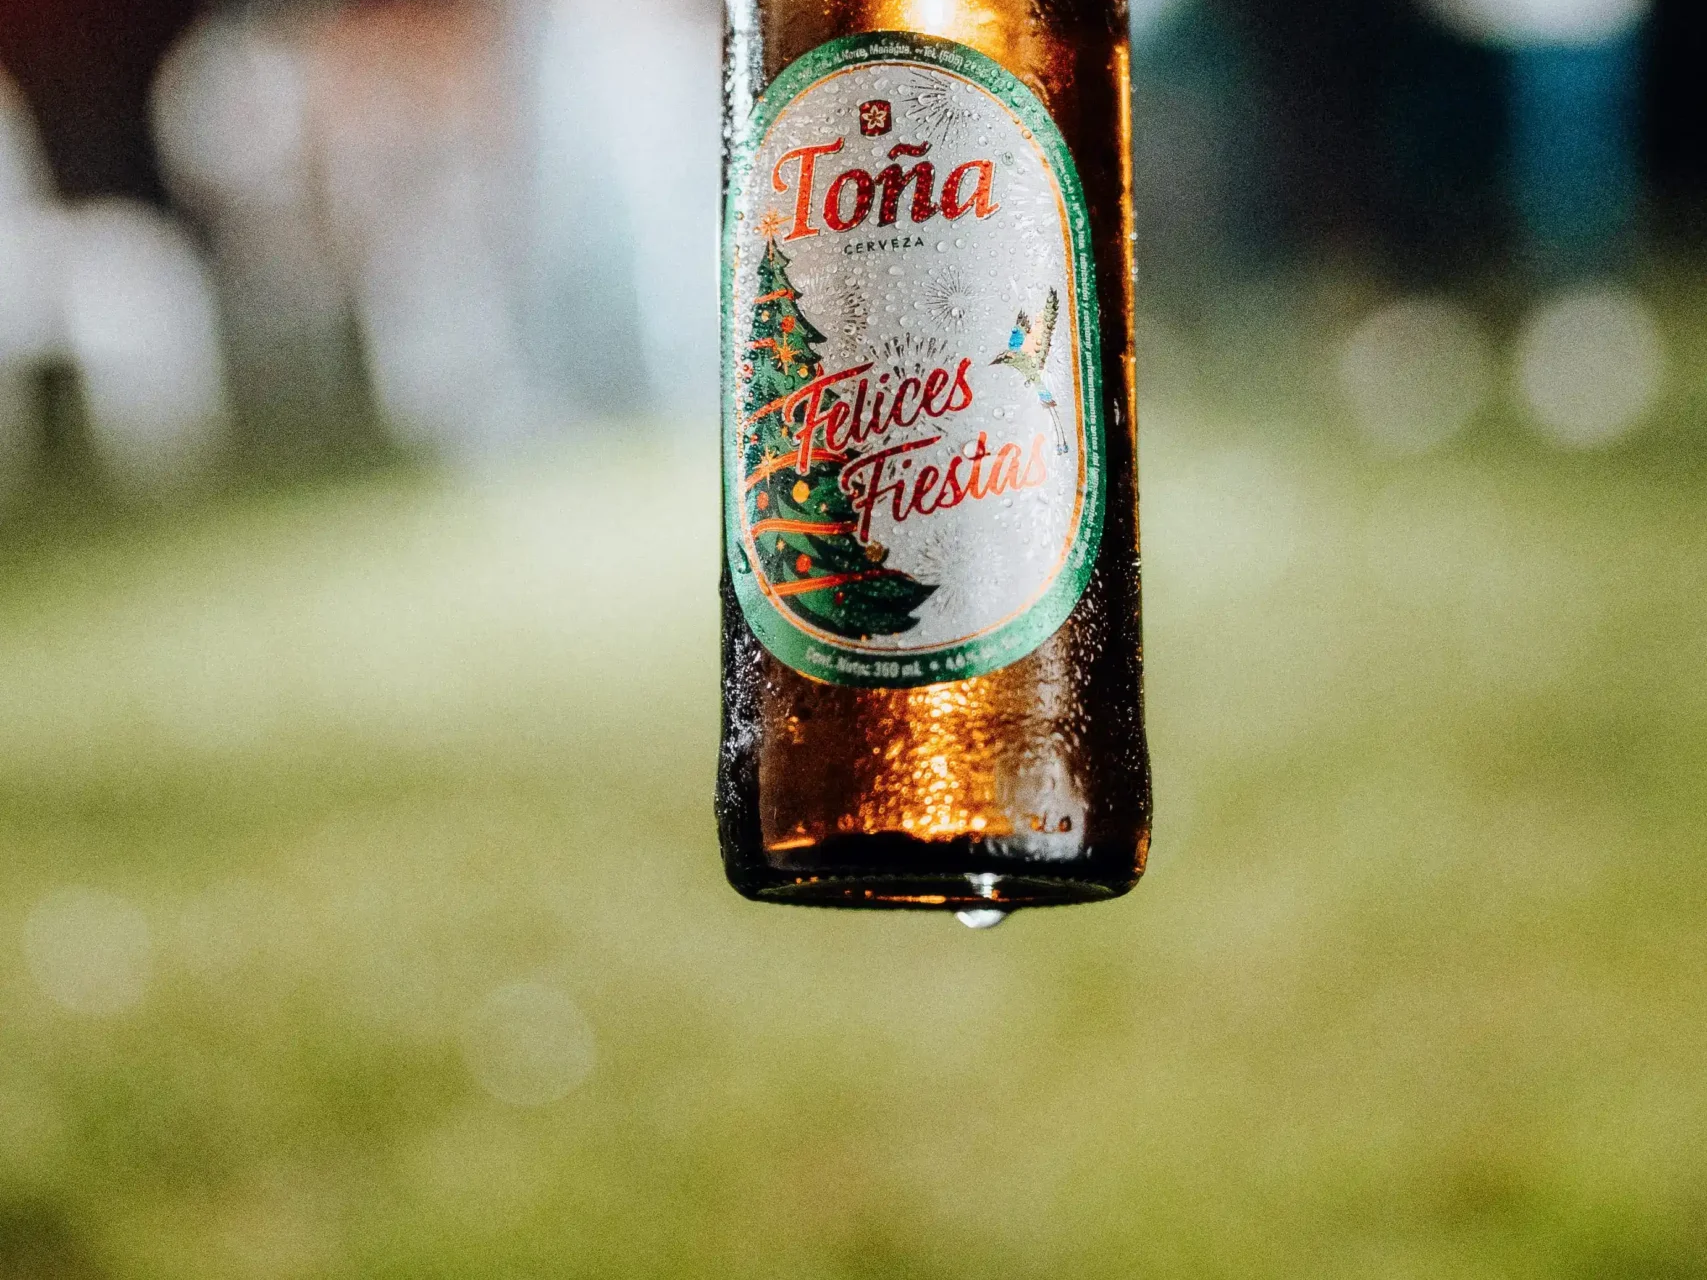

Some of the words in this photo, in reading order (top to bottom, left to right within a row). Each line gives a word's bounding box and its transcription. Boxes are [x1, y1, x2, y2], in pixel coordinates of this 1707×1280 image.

[939, 49, 964, 70] (505)
[771, 137, 1000, 241] Toña
[843, 237, 925, 255] CERVEZA
[1083, 310, 1094, 349] consumir
[1085, 352, 1097, 424] preferentemente
[783, 357, 972, 476] Felices
[1090, 425, 1098, 450] antes
[1092, 451, 1100, 466] del
[840, 431, 1047, 542] Fiestas
